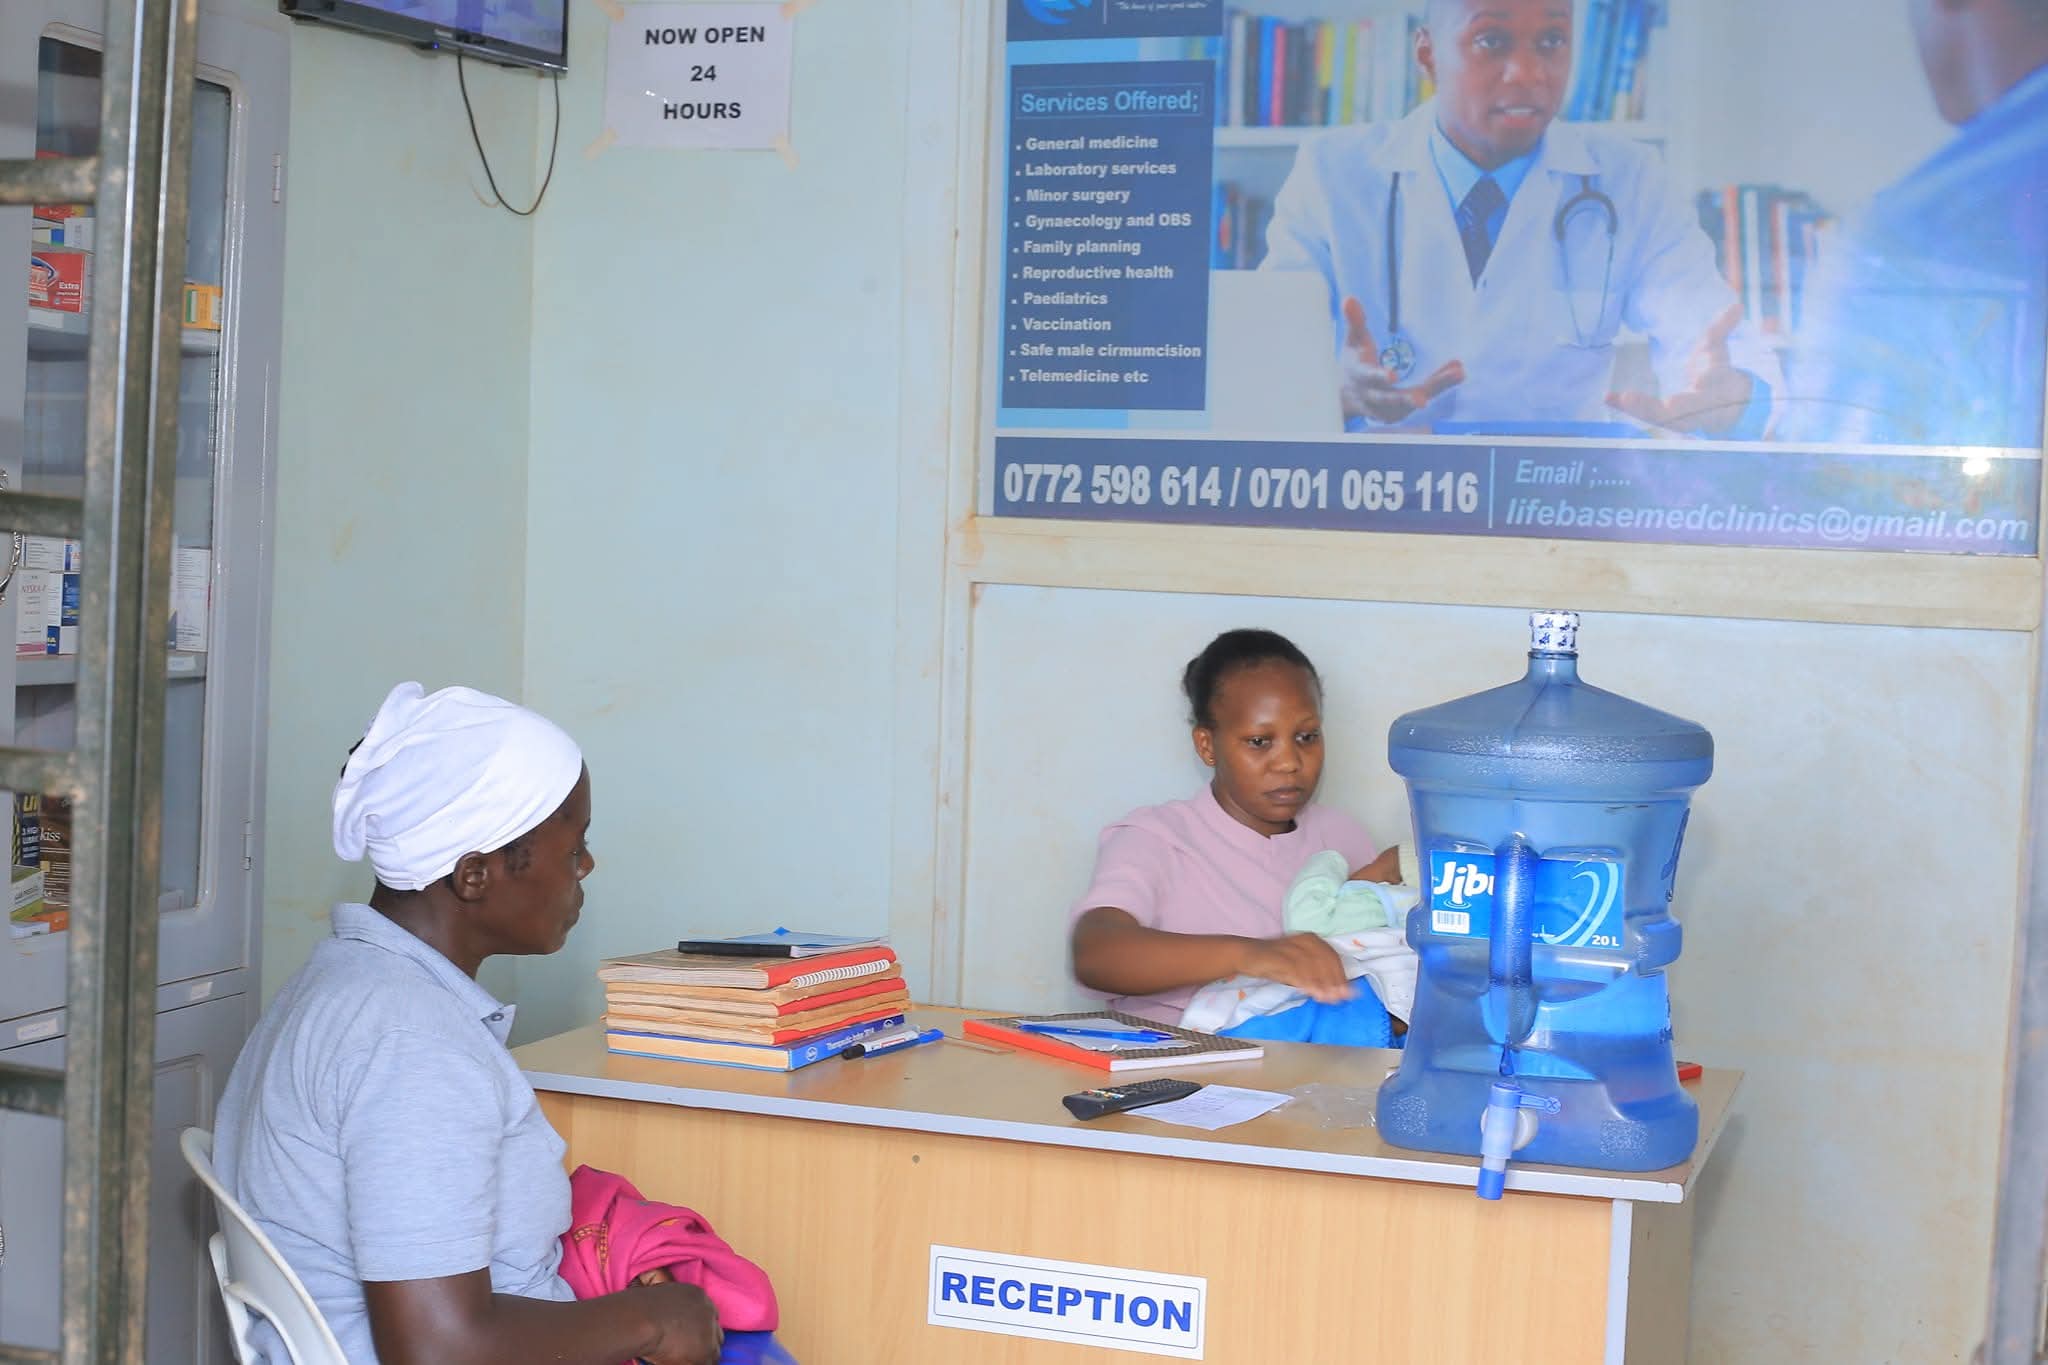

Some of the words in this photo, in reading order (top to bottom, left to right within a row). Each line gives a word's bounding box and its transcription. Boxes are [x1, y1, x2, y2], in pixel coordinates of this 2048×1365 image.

[645, 28, 697, 45] NOW
[705, 26, 765, 44] OPEN
[690, 65, 716, 82] 24
[1021, 93, 1109, 113] Services
[1115, 90, 1199, 112] Offered;
[663, 102, 742, 120] HOURS
[1025, 136, 1085, 150] General
[1089, 135, 1159, 149] medicine
[1025, 163, 1108, 178] Laboratory
[1111, 161, 1177, 175] services
[1026, 189, 1069, 202] Minor
[1072, 190, 1131, 204] surgery
[1025, 214, 1123, 231] Gynaecology
[1126, 213, 1154, 226] and
[1159, 213, 1192, 226] OBS
[1023, 240, 1072, 256] Family
[1076, 240, 1141, 256] planning
[1023, 266, 1122, 282] Reproductive
[1126, 265, 1174, 279] health
[1023, 292, 1108, 305] Paediatrics
[1023, 318, 1112, 331] Vaccination
[1020, 343, 1053, 357] Safe
[1057, 344, 1094, 357] male
[1098, 343, 1201, 358] cirmumcision
[1019, 368, 1120, 383] Telemedicine
[1123, 370, 1149, 383] etc
[1515, 459, 1584, 486] Email
[1003, 463, 1082, 504] 0772
[1091, 465, 1151, 506] 598
[1160, 466, 1222, 507] 614
[1249, 468, 1329, 510] 0701
[1341, 469, 1404, 512] 065
[1415, 471, 1479, 514] 116
[1506, 499, 2030, 542] lifebasemedclinics@gmail.com
[40, 826, 61, 841] kiss
[1592, 934, 1609, 946] 20
[1612, 937, 1620, 947] L
[941, 1271, 1192, 1333] RECEPTION
